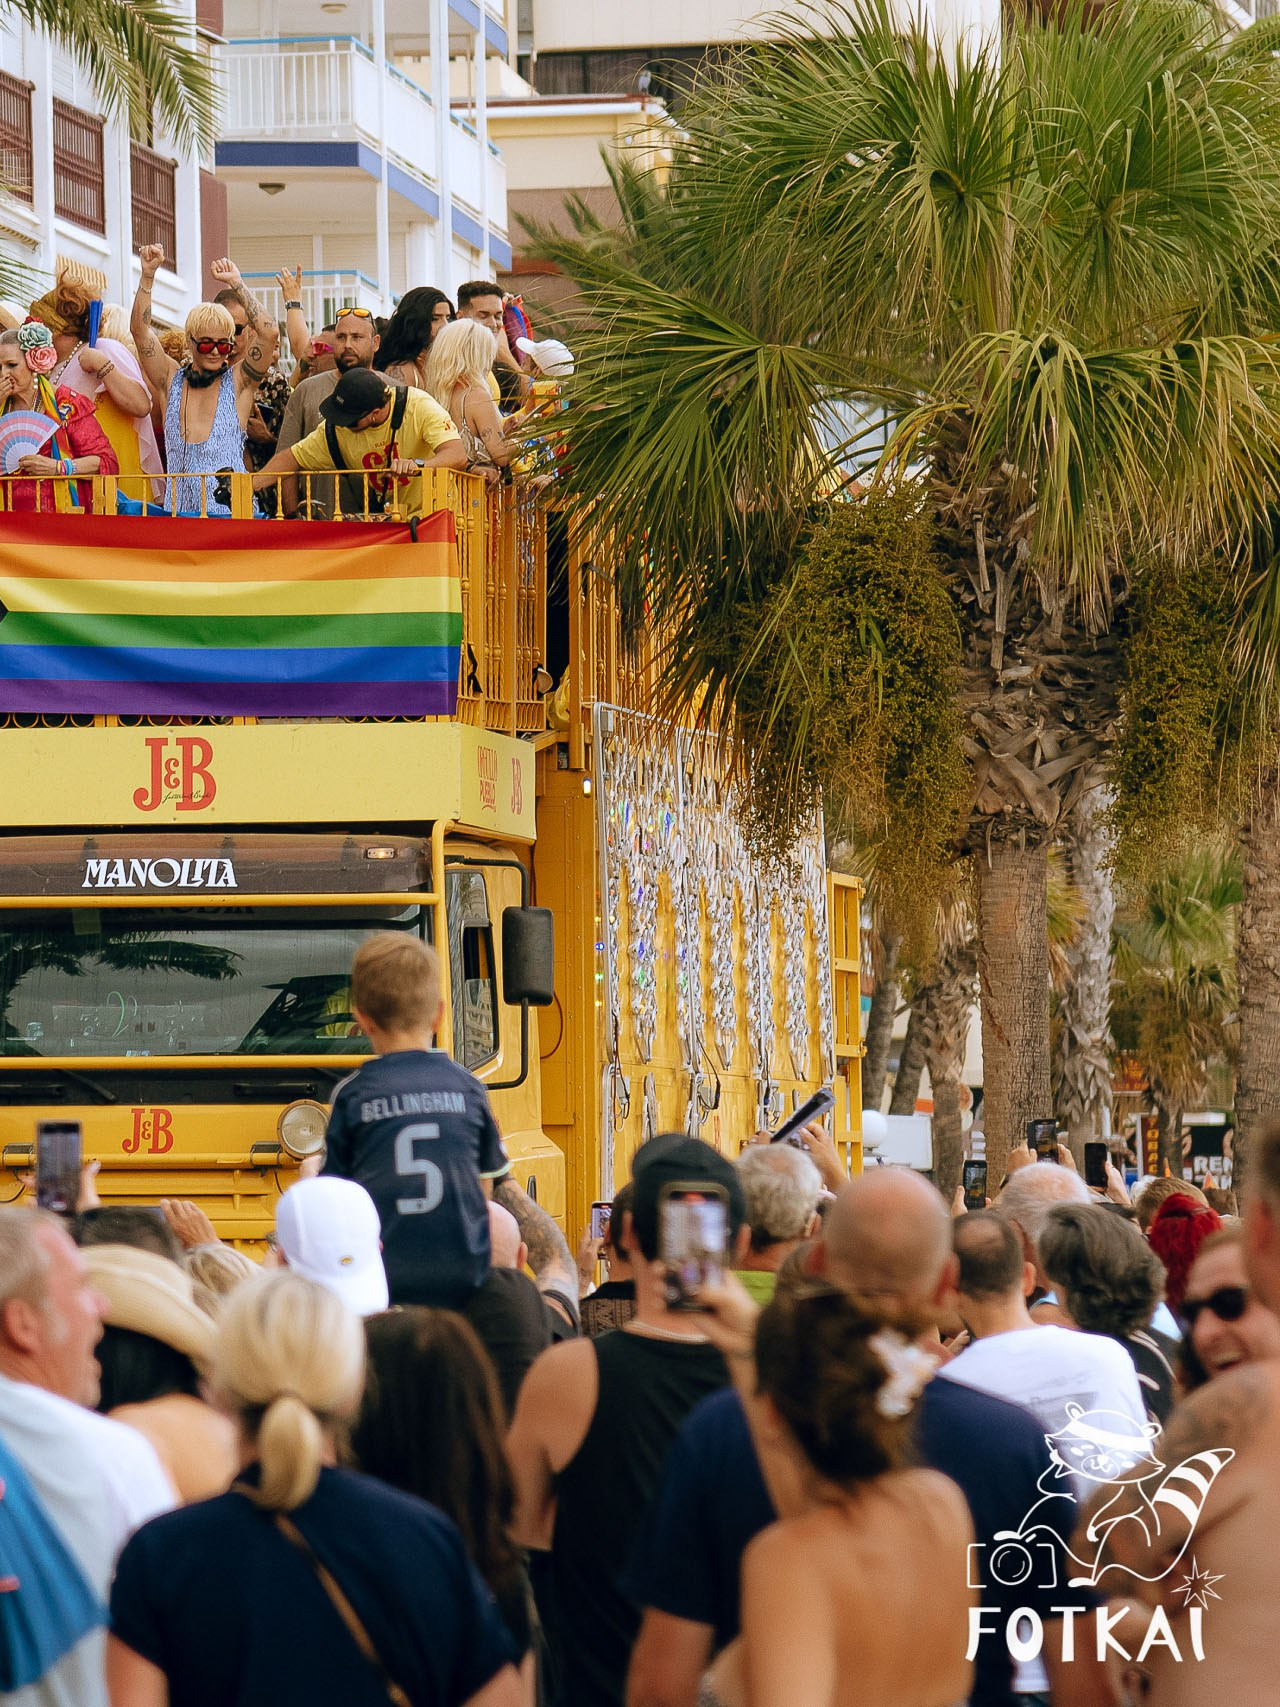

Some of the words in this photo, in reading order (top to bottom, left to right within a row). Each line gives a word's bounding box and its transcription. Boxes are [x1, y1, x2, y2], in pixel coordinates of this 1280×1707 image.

[133, 737, 217, 812] J&B
[81, 858, 238, 888] MANOLITA
[360, 1090, 467, 1123] BELLINGHAM
[122, 1108, 174, 1154] J&B
[1146, 1115, 1160, 1176] TOBAC
[394, 1122, 444, 1215] 5
[1193, 1155, 1233, 1174] REN
